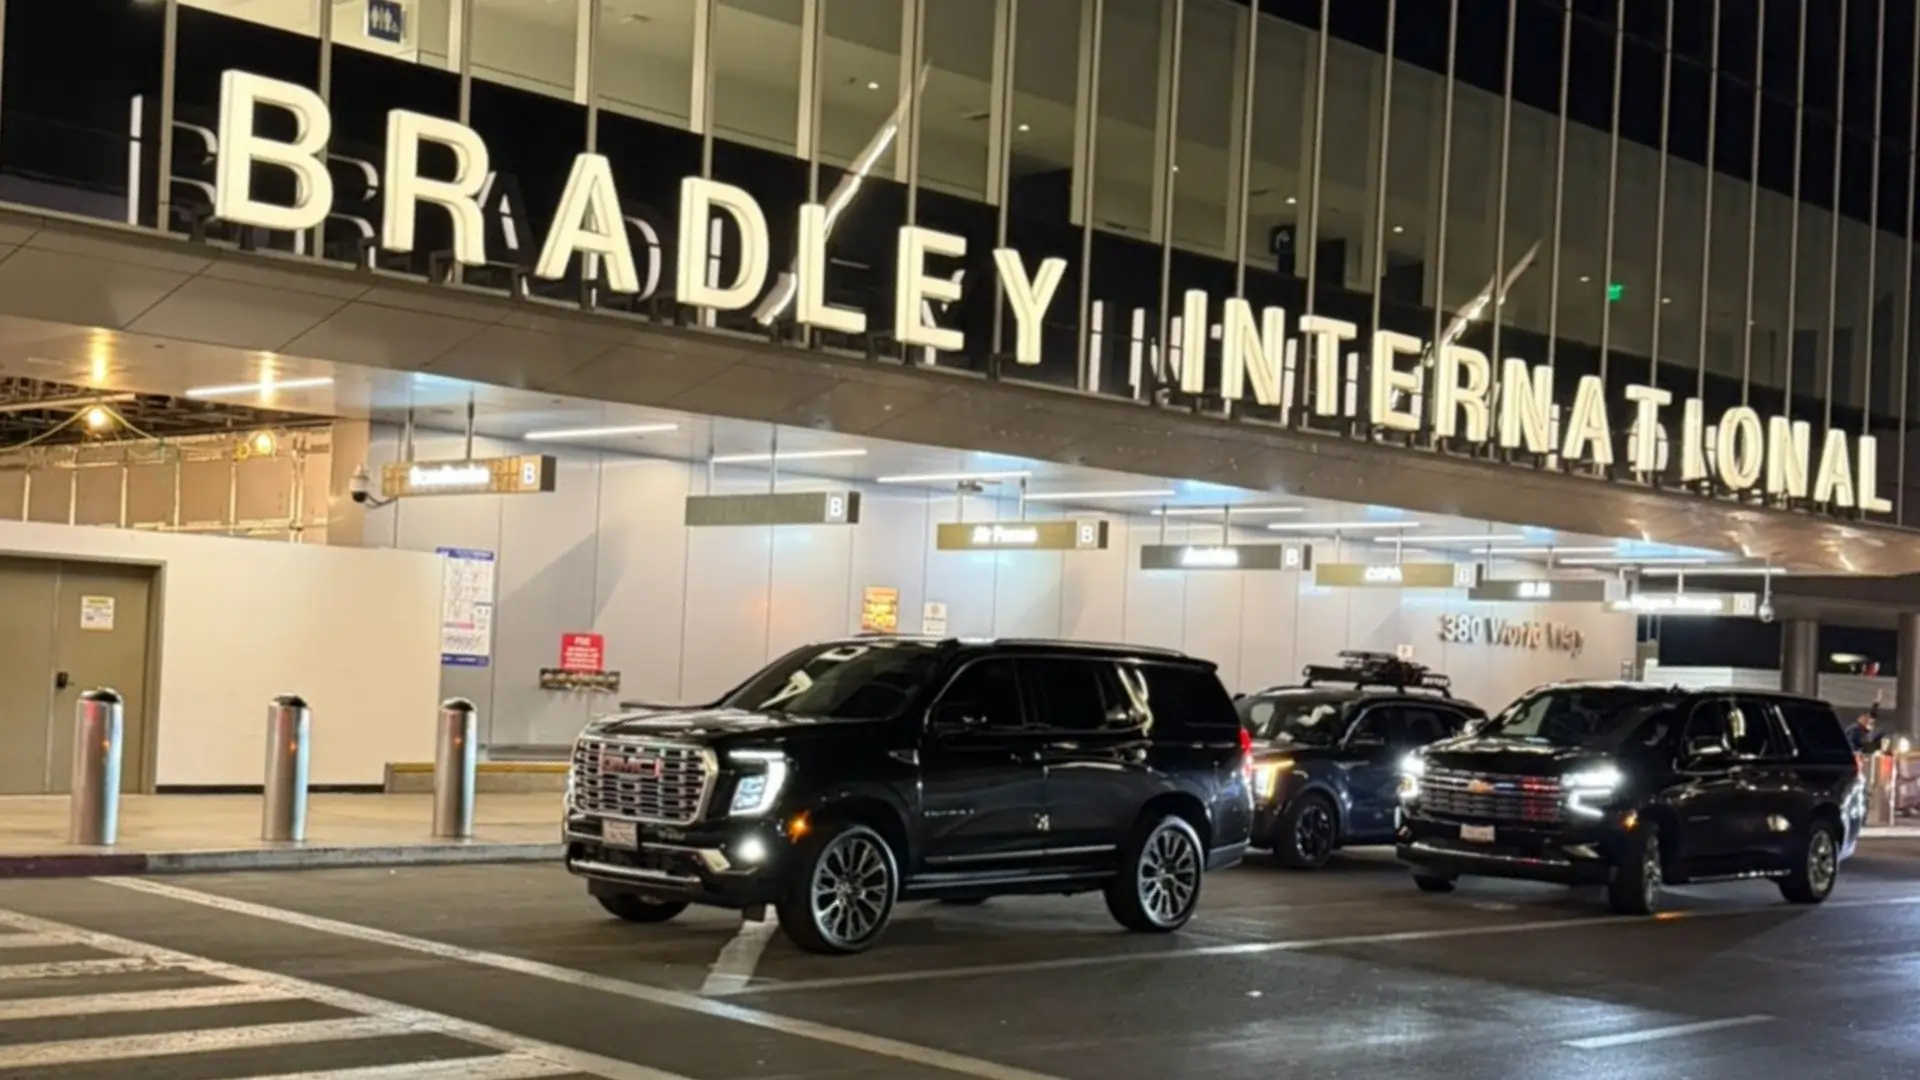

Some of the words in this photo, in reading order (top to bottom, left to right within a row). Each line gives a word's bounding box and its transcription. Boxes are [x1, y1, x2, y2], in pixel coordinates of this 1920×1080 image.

[214, 69, 1067, 364] BRADLEY
[1181, 289, 1892, 513] INTERNATIONAL
[829, 496, 842, 517] B
[1081, 525, 1094, 543] B
[1440, 613, 1482, 643] 380
